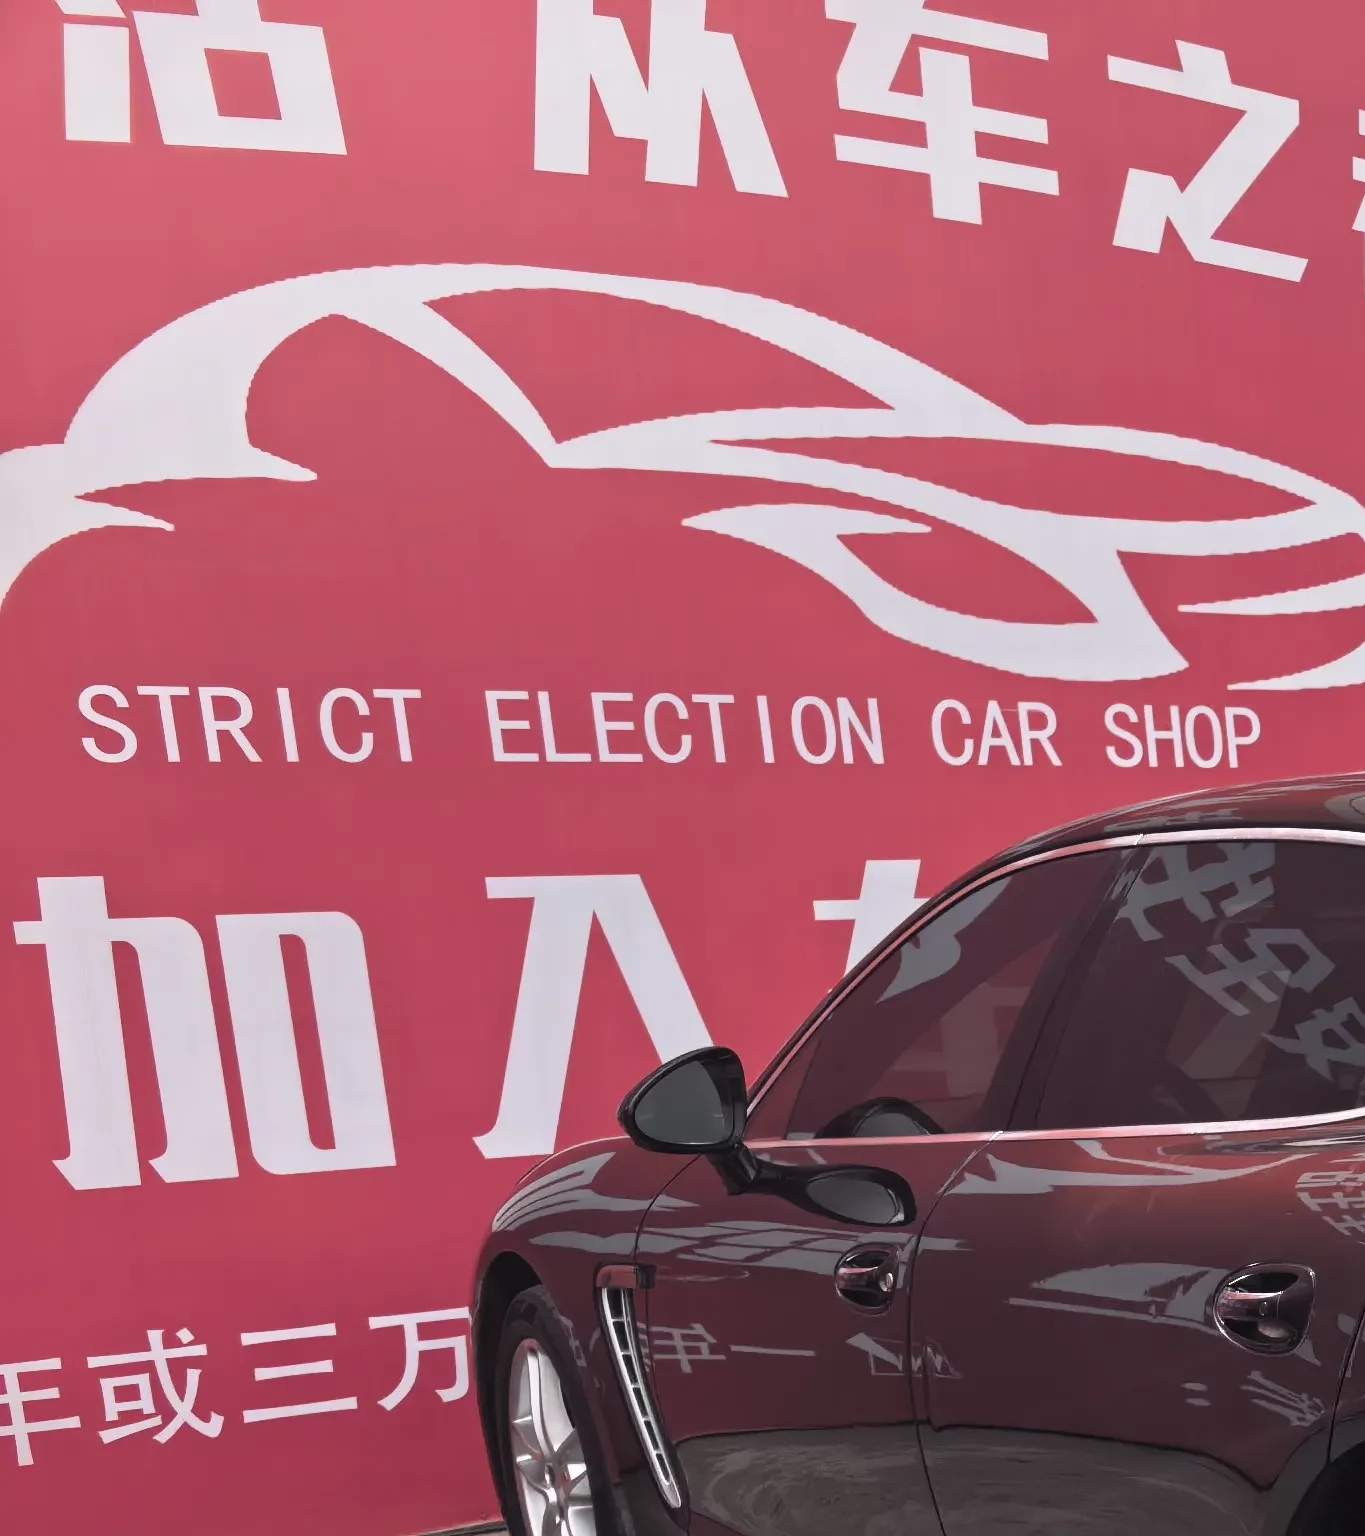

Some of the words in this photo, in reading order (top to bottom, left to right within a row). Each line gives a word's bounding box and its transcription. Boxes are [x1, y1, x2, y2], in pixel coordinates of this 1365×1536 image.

[80, 685, 422, 764] STRICT
[485, 690, 885, 766] ELECTION
[932, 698, 1062, 768] CAR
[1104, 705, 1261, 769] SHOP
